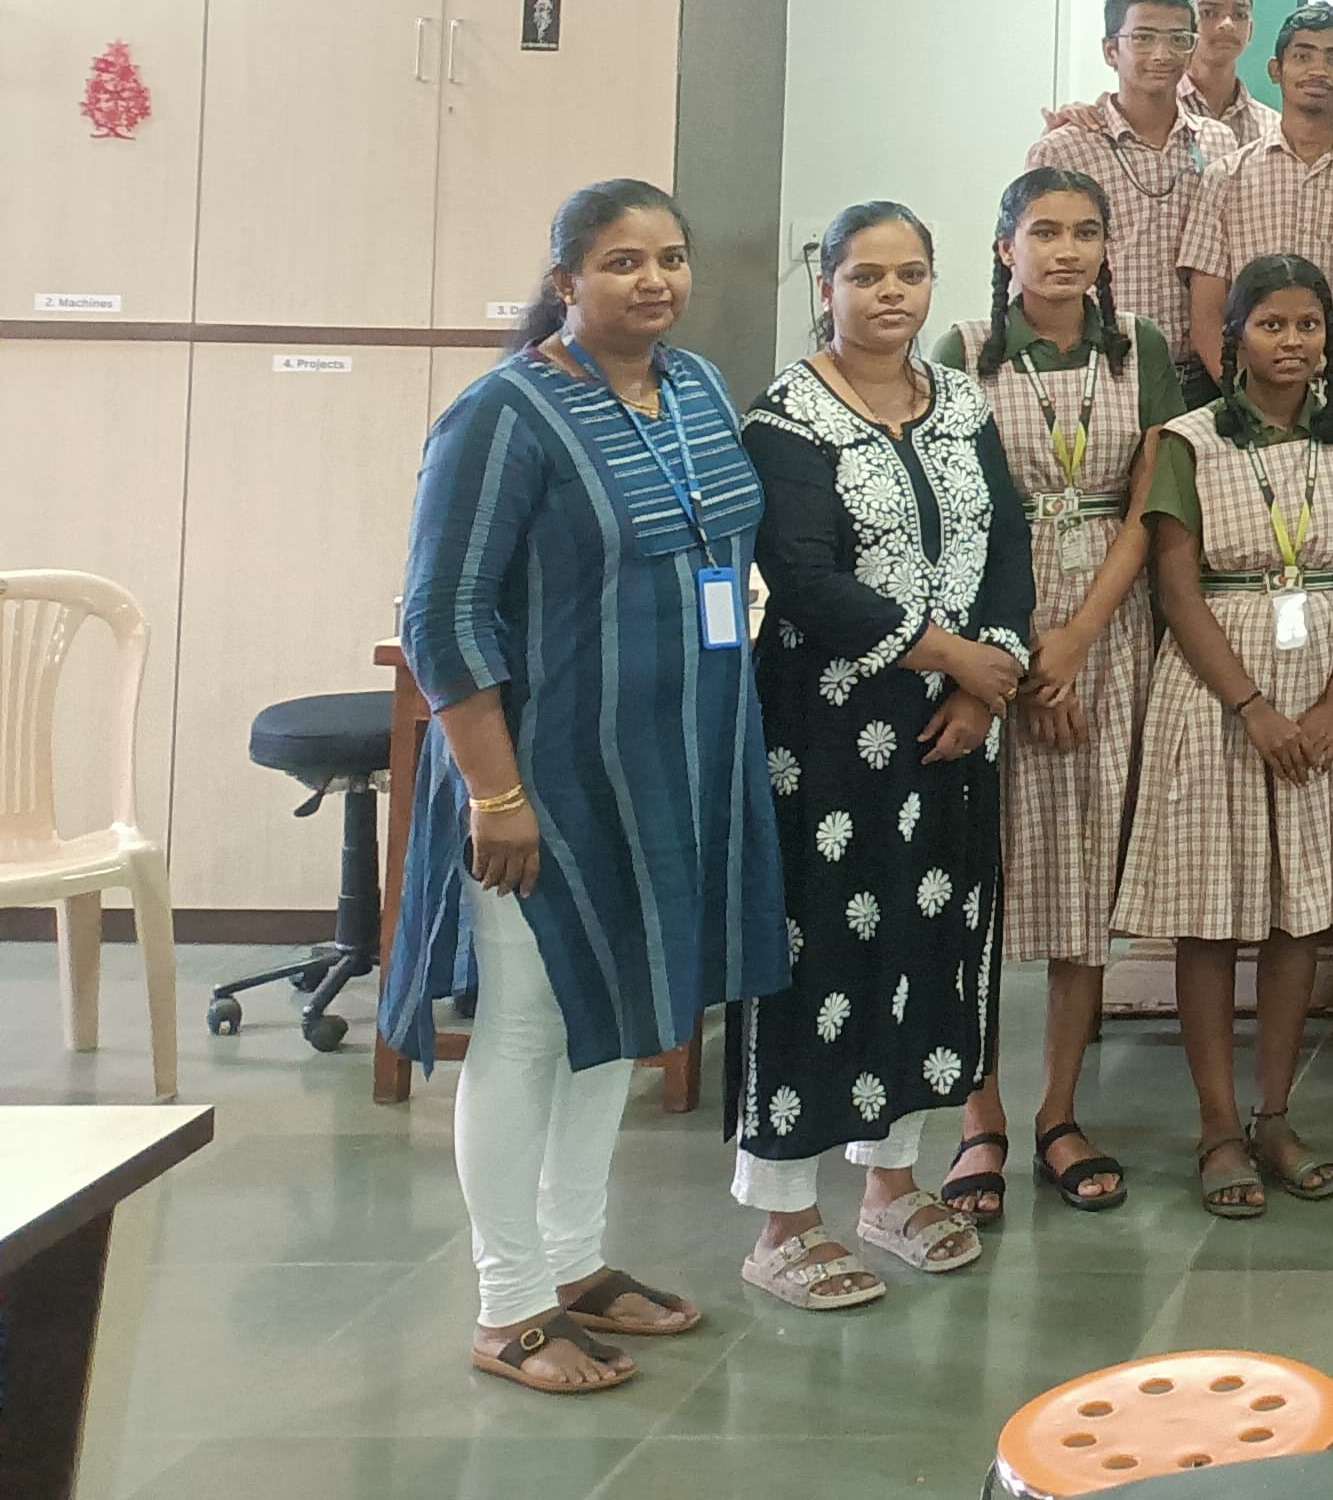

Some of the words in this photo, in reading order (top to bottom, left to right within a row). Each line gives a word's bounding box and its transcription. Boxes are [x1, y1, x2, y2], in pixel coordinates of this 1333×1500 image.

[58, 297, 113, 309] Machines
[282, 358, 294, 369] 4.
[296, 358, 345, 372] Projects
